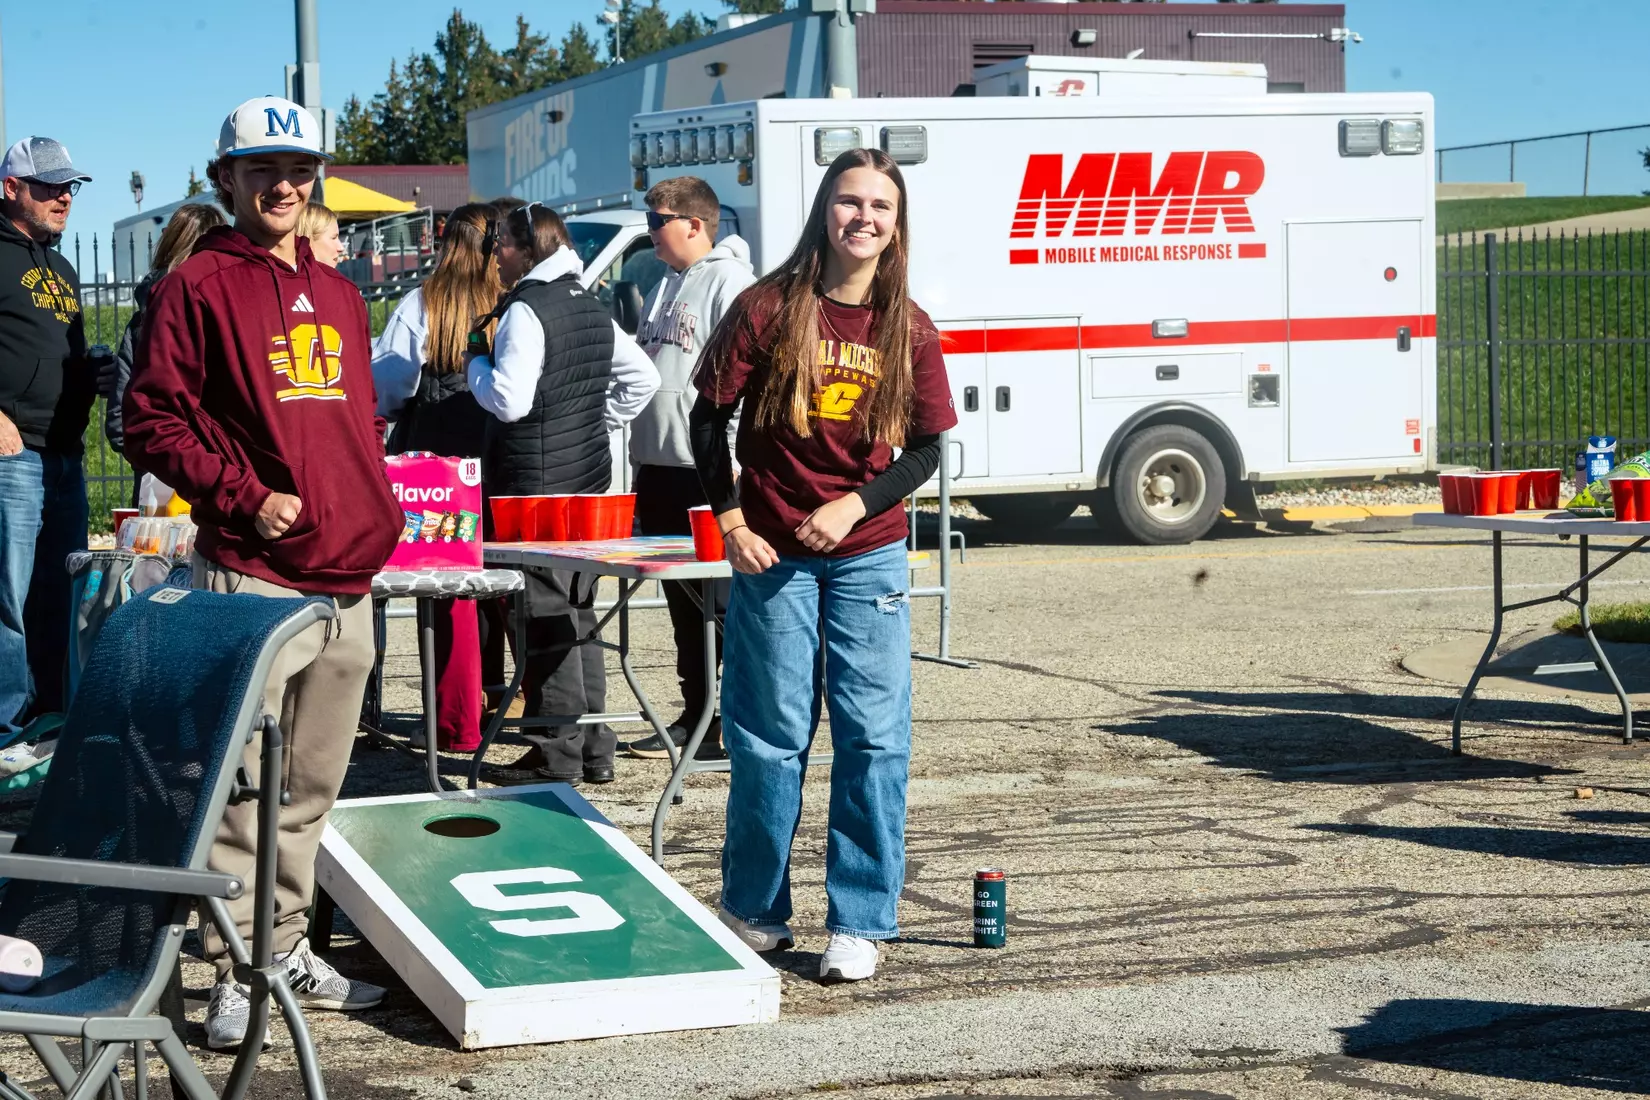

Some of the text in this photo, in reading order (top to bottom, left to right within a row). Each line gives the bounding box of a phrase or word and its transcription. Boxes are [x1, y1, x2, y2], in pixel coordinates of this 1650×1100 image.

[264, 107, 303, 138] M
[505, 100, 546, 188] FIRE
[1009, 151, 1266, 239] MMR
[1045, 244, 1232, 264] MOBILE MEDICAL RESPONSE
[838, 341, 882, 378] MICH
[820, 367, 877, 389] PPEWAS
[465, 462, 476, 475] 18
[392, 482, 454, 503] flavor
[449, 866, 627, 938] S
[977, 891, 990, 899] GO
